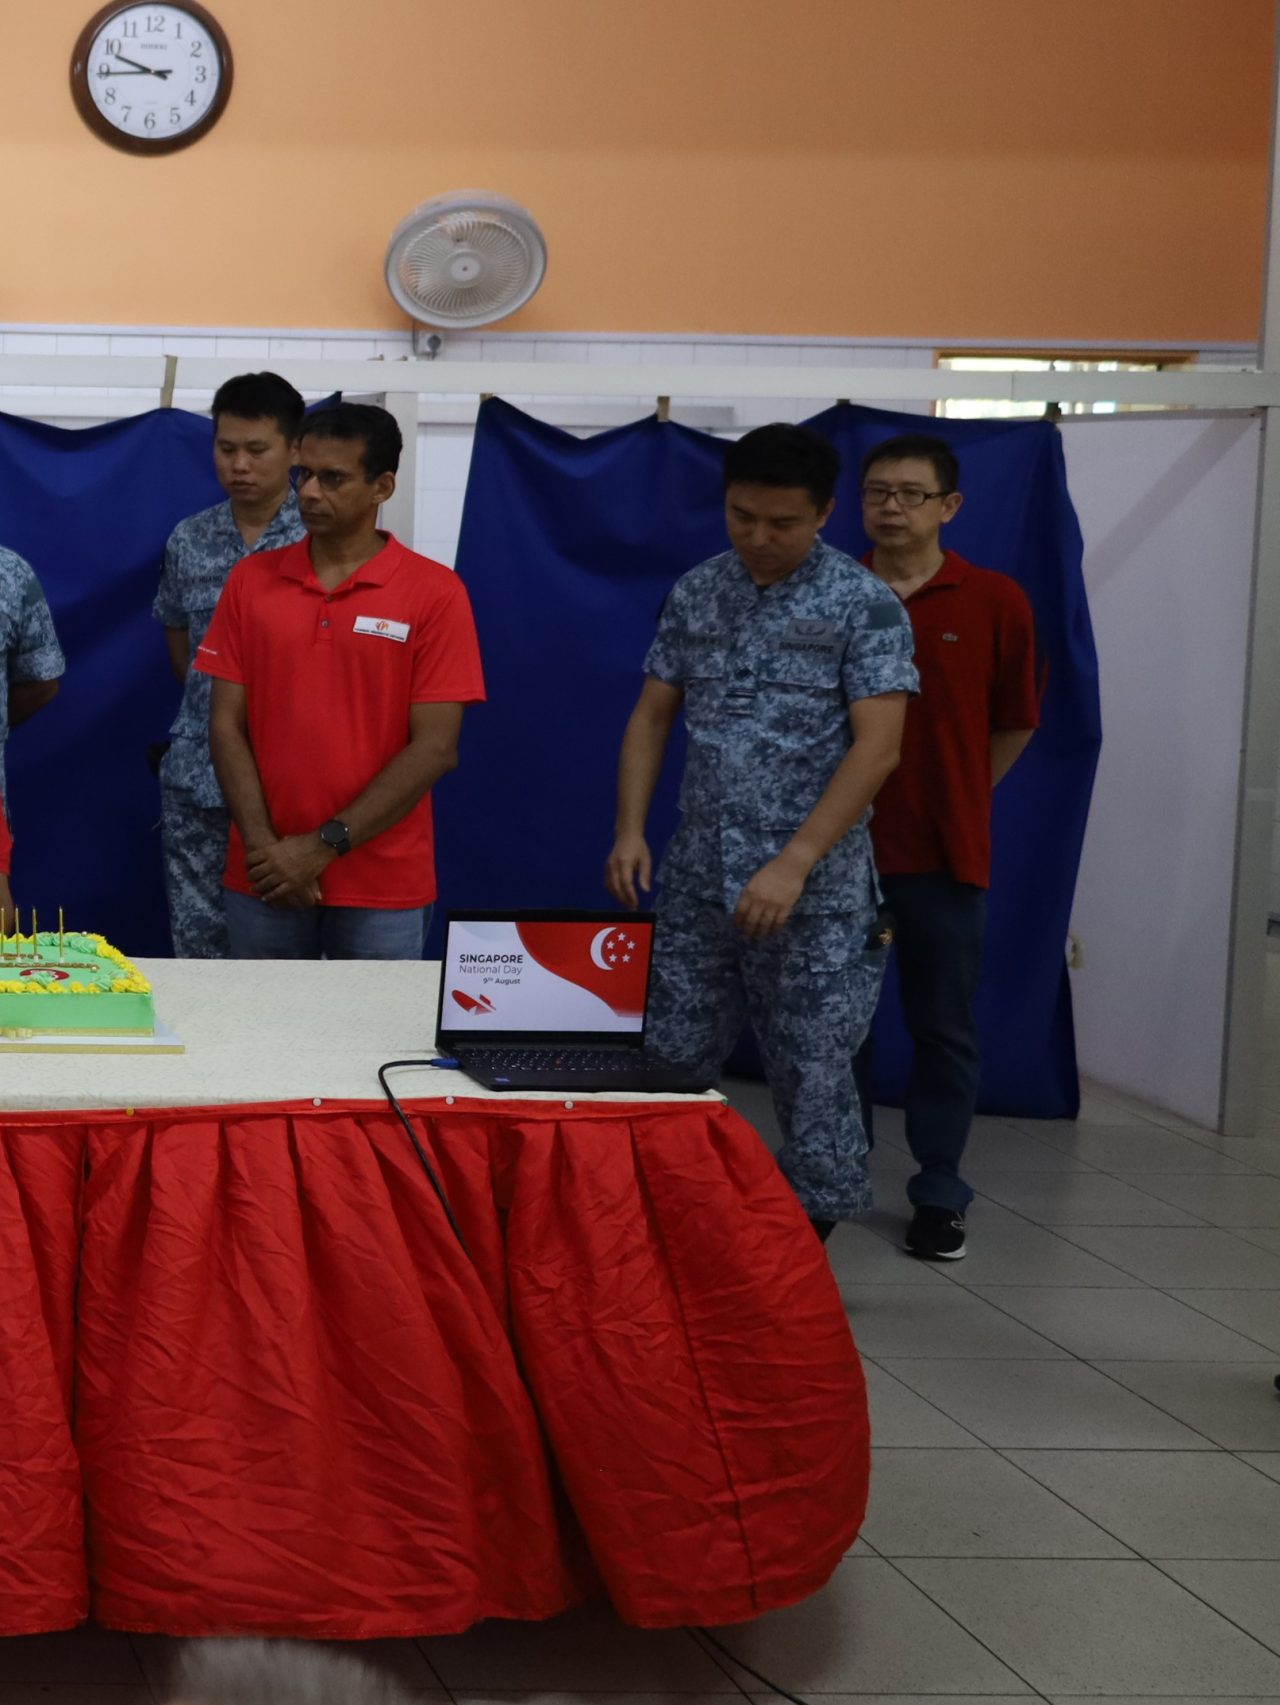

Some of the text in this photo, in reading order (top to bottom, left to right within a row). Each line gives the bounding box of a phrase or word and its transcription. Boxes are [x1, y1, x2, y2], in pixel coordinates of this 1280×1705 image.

[122, 20, 138, 38] 11
[145, 15, 165, 33] 12
[175, 22, 183, 40] 1
[105, 39, 122, 56] 10
[190, 41, 202, 58] 2
[98, 63, 111, 80] 9
[194, 66, 207, 83] 3
[104, 87, 117, 105] 8
[184, 89, 197, 107] 4
[121, 105, 132, 123] 7
[144, 112, 156, 130] 6
[170, 107, 181, 125] 5
[779, 641, 834, 654] SINGAPORE
[459, 954, 524, 964] SINGAPORE
[459, 964, 522, 976] National Day
[495, 978, 521, 986] August
